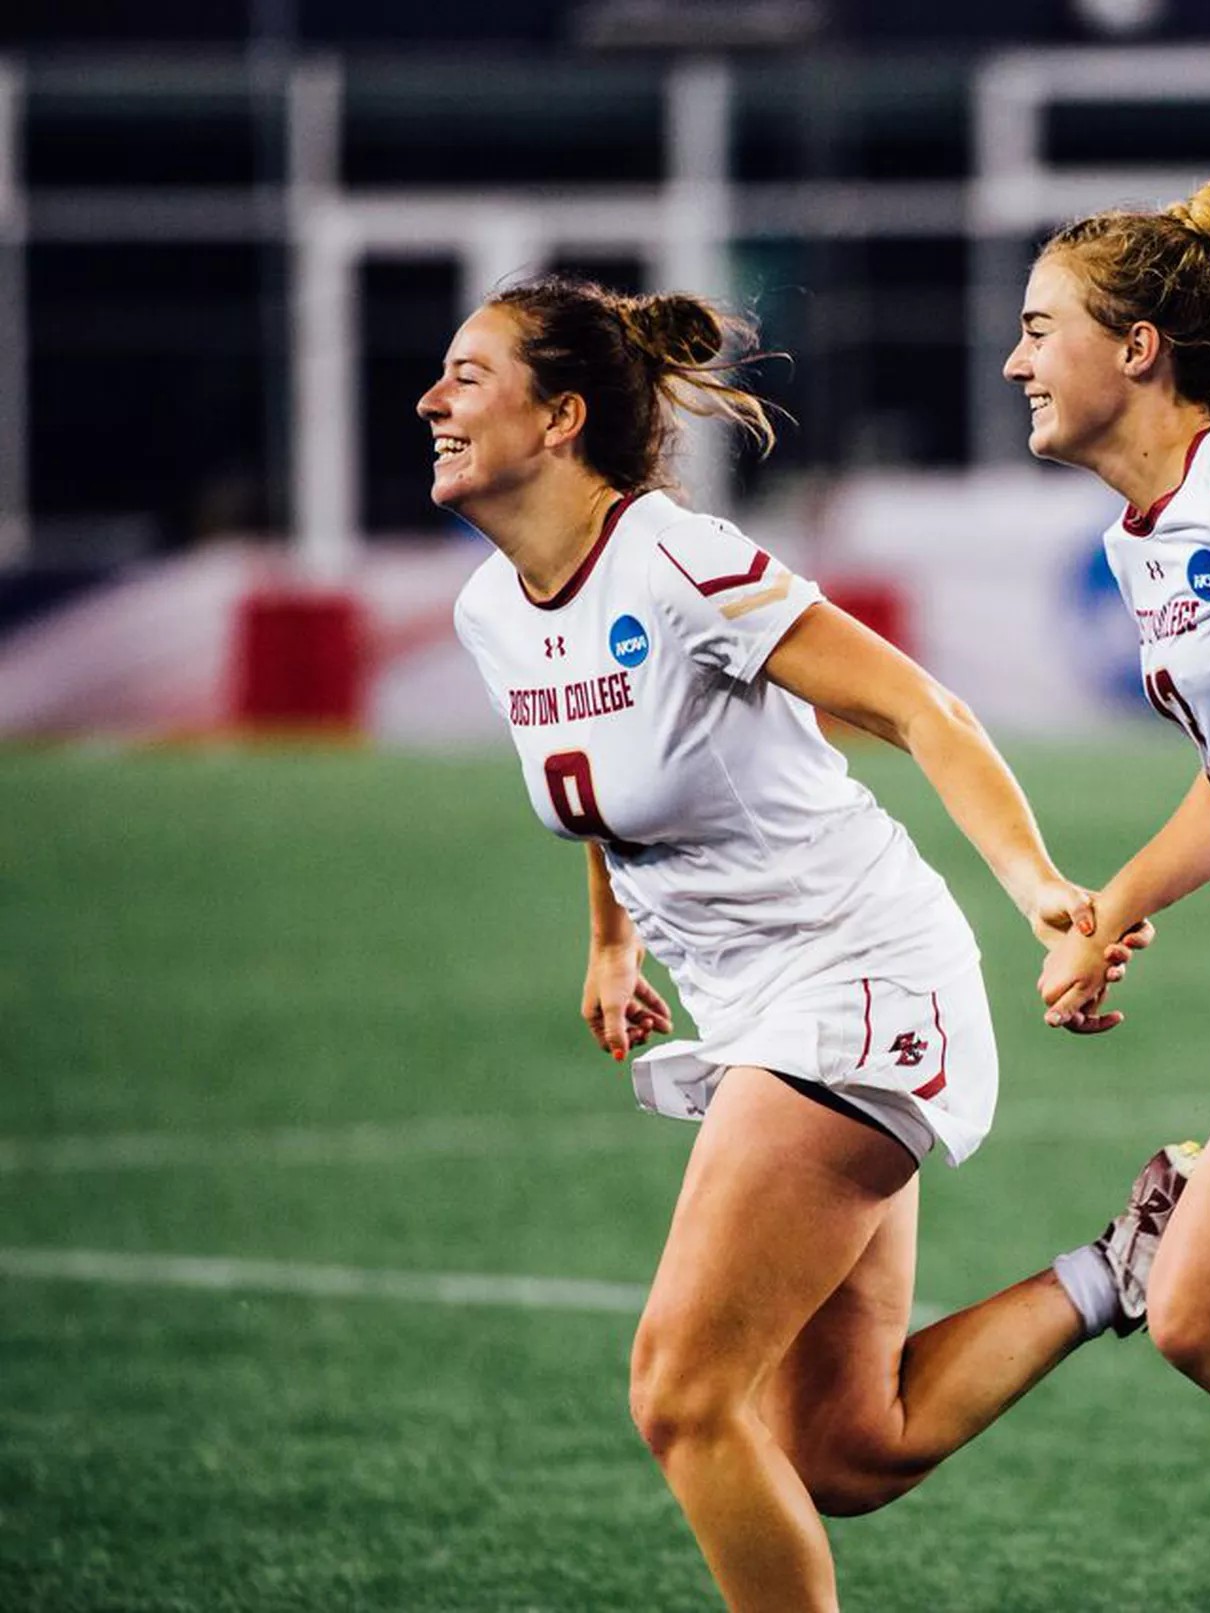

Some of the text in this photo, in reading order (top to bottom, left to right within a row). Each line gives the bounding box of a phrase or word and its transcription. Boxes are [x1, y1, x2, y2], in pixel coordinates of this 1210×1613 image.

[615, 635, 647, 657] NCAA
[509, 671, 634, 726] BOSTON COLLEGE
